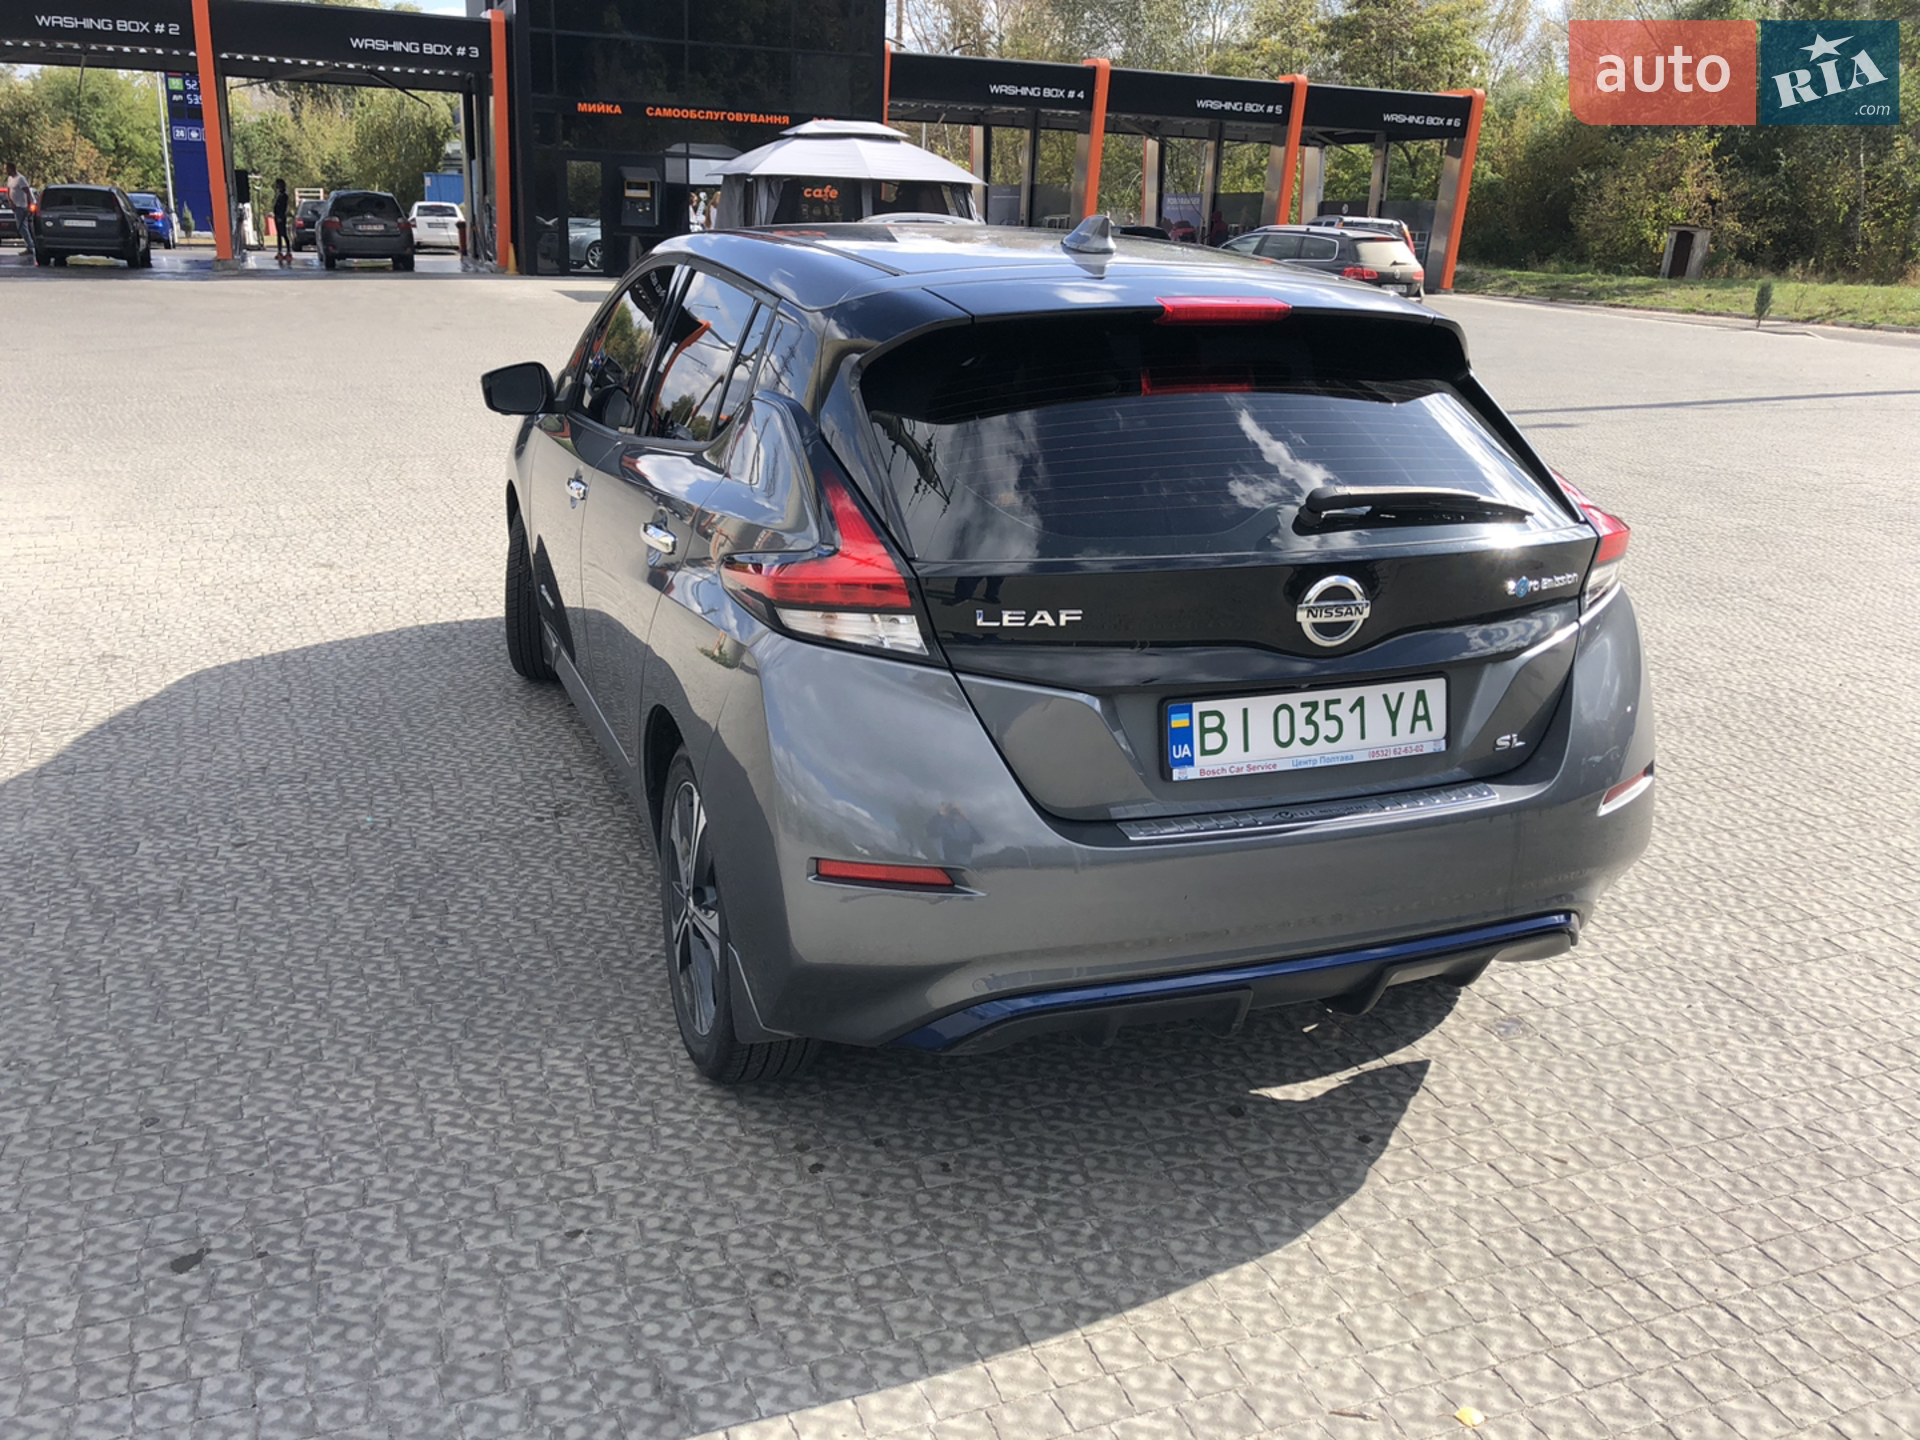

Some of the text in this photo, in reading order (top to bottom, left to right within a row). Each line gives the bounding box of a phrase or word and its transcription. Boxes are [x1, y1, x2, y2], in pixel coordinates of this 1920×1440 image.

[35, 14, 180, 36] WASHING BOX # 2
[350, 37, 480, 58] WASHING BOX # 3
[988, 84, 1085, 100] WASHING BOX # 4
[577, 101, 790, 125] МИЙКА САМООБСЛУГОВУВАННЯ
[1196, 99, 1283, 115] WASHING BOX # 5
[1383, 113, 1425, 125] WASHING
[1426, 115, 1445, 126] BOX
[803, 185, 839, 203] cafe
[975, 609, 1084, 627] LEAF
[1306, 605, 1365, 619] NISSAN
[1198, 689, 1434, 757] BI 0351 YA
[1494, 733, 1527, 751] SL
[1172, 744, 1192, 759] UA
[1199, 767, 1228, 777] Bosch
[1229, 765, 1244, 775] Car
[1246, 762, 1278, 773] Service
[1291, 757, 1318, 768] Центр
